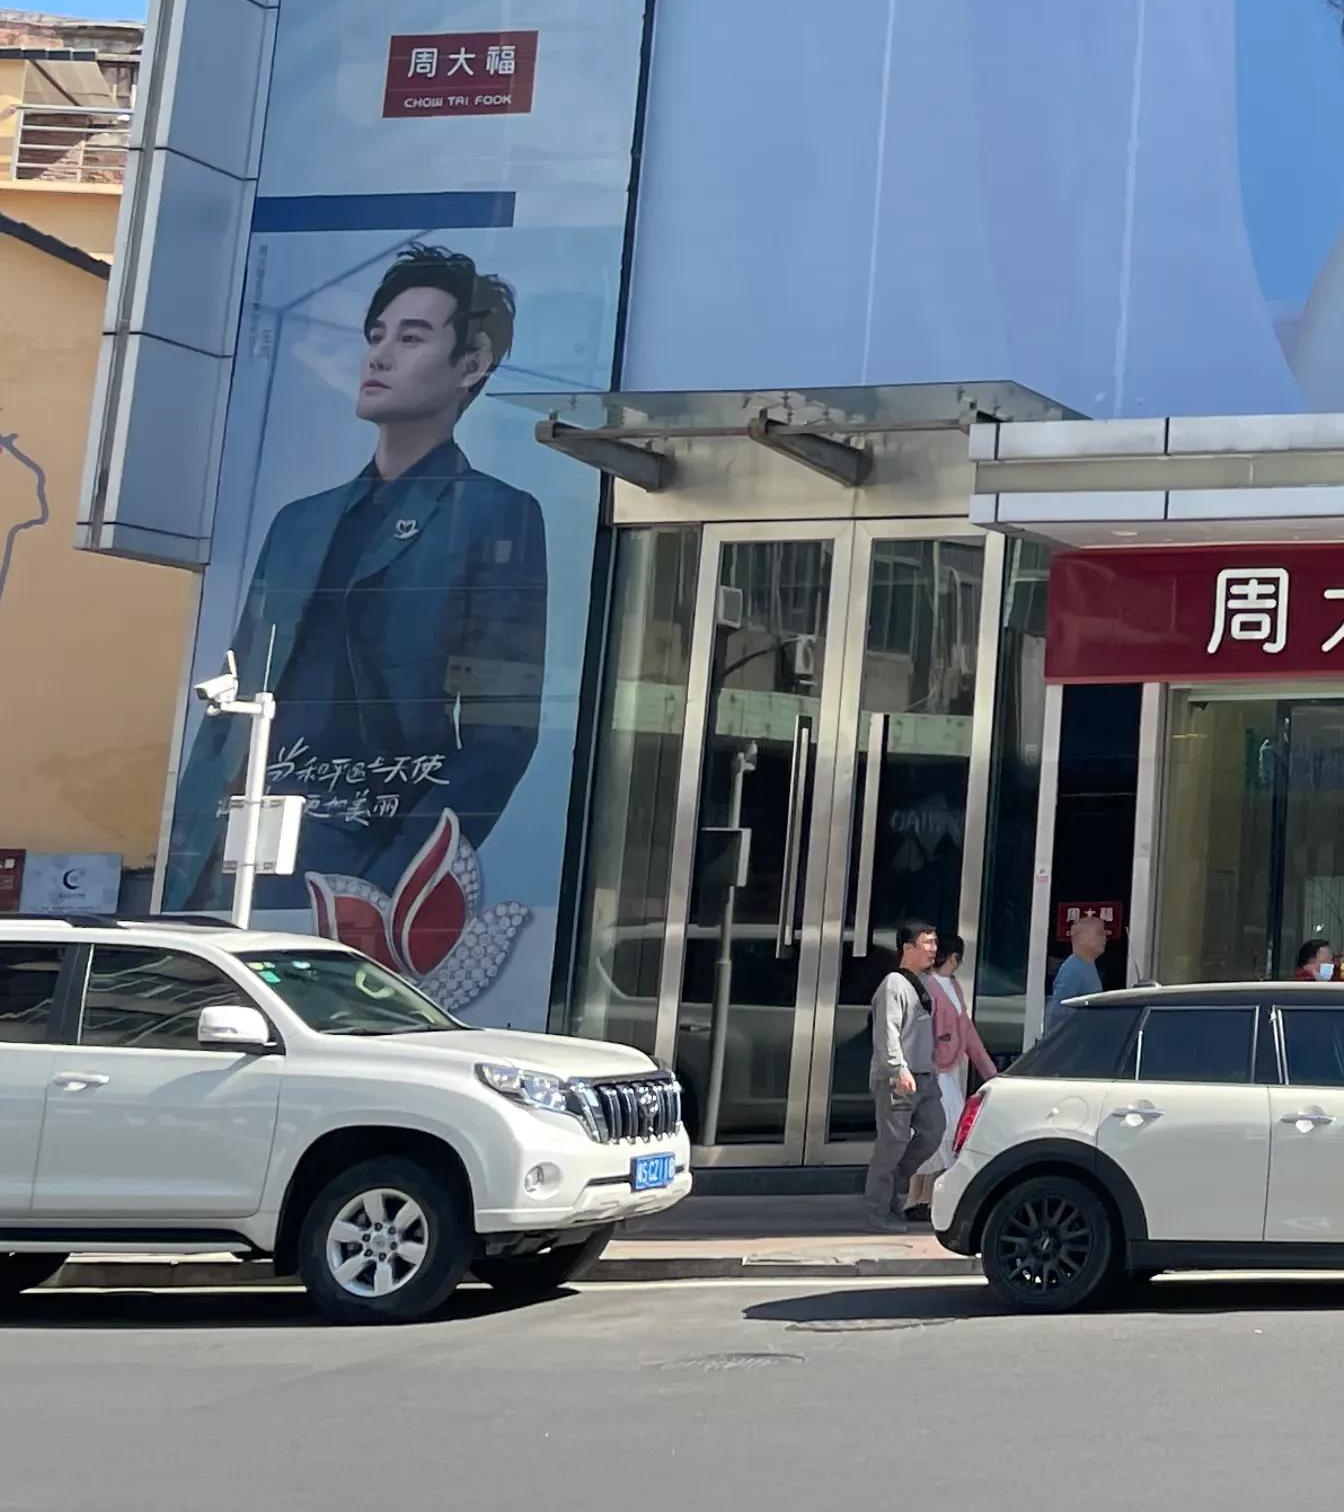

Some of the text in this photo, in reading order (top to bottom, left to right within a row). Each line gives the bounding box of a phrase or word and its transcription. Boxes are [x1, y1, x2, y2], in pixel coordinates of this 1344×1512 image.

[407, 45, 516, 78] 周大福
[404, 94, 512, 108] CHOW TAI FOOK
